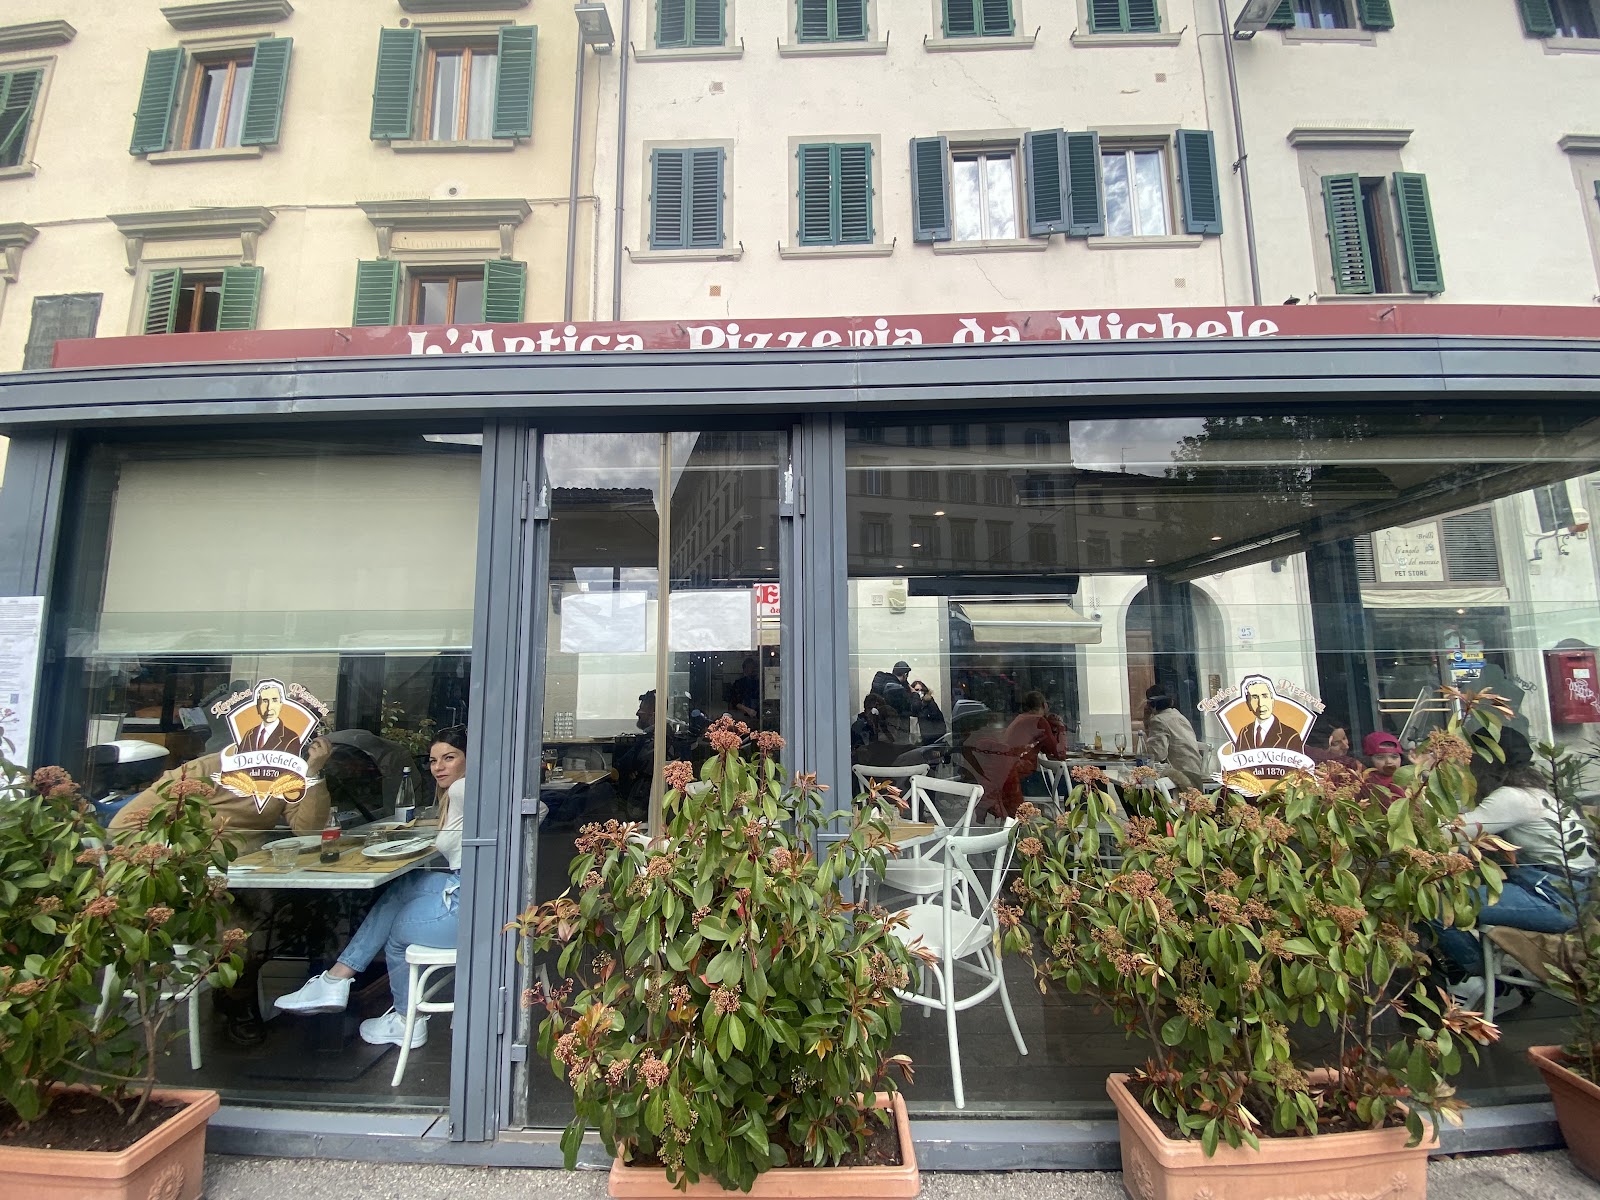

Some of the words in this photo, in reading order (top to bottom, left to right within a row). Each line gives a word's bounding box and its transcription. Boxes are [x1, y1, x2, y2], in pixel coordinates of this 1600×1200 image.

[1277, 678, 1326, 712] Pizzeria
[234, 755, 253, 768] Da
[1232, 753, 1255, 767] Da
[1257, 751, 1303, 766] Michele
[249, 769, 260, 777] dal
[262, 769, 280, 777] 1870
[1253, 768, 1264, 776] dal
[1266, 768, 1286, 776] 1870
